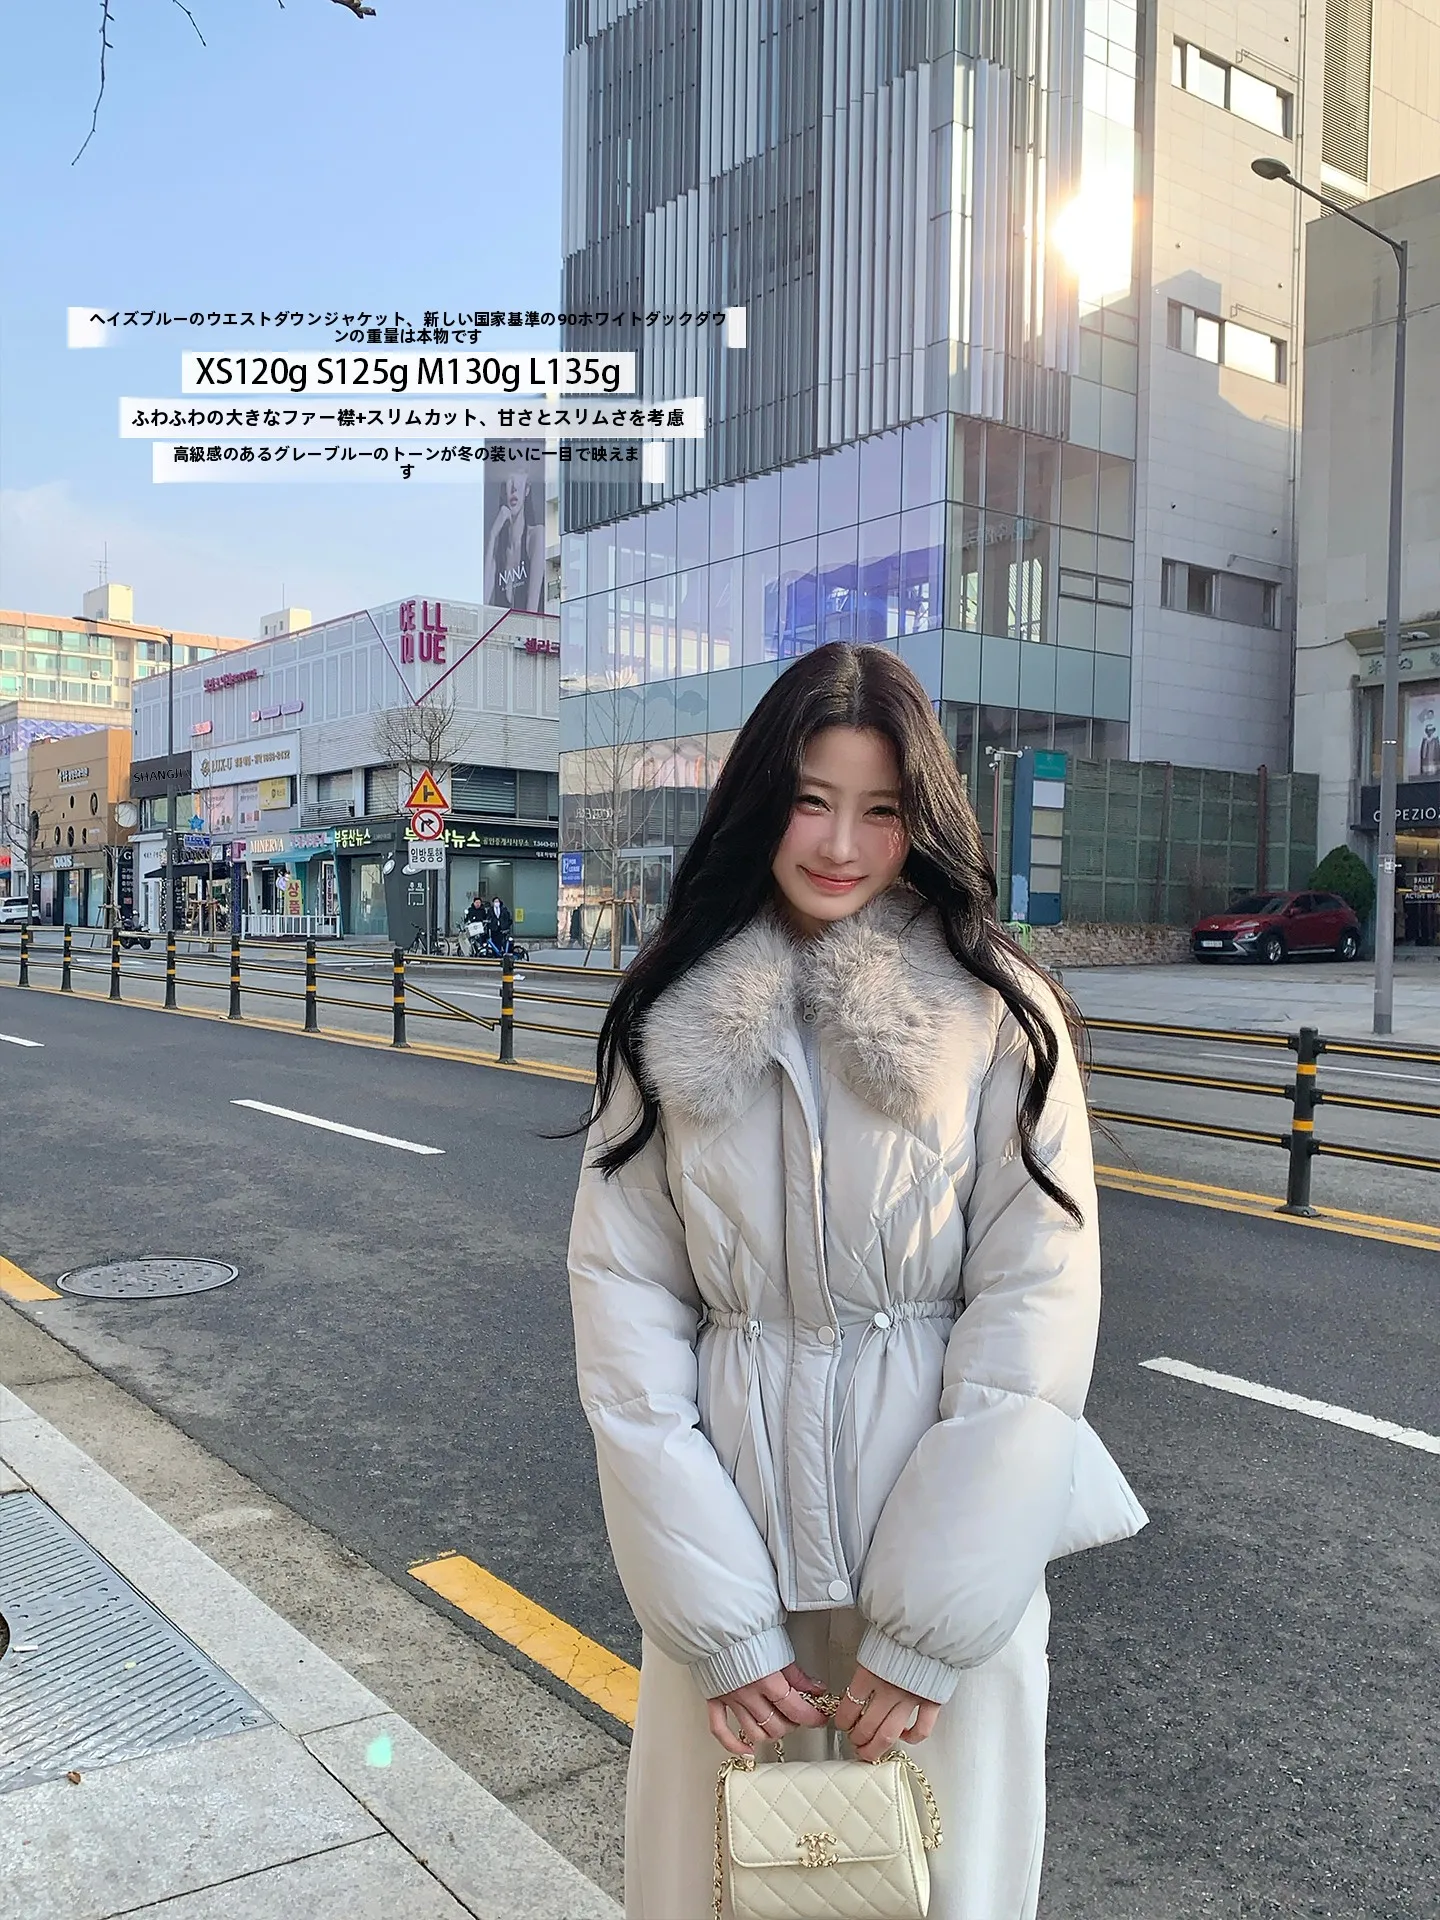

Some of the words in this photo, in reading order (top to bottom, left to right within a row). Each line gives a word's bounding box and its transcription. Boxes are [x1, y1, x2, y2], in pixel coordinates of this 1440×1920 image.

[250, 838, 285, 854] MINERVA
[334, 827, 371, 848] 부동산뉴스
[403, 827, 481, 848] 부산뉴스
[410, 847, 444, 863] 일방통행
